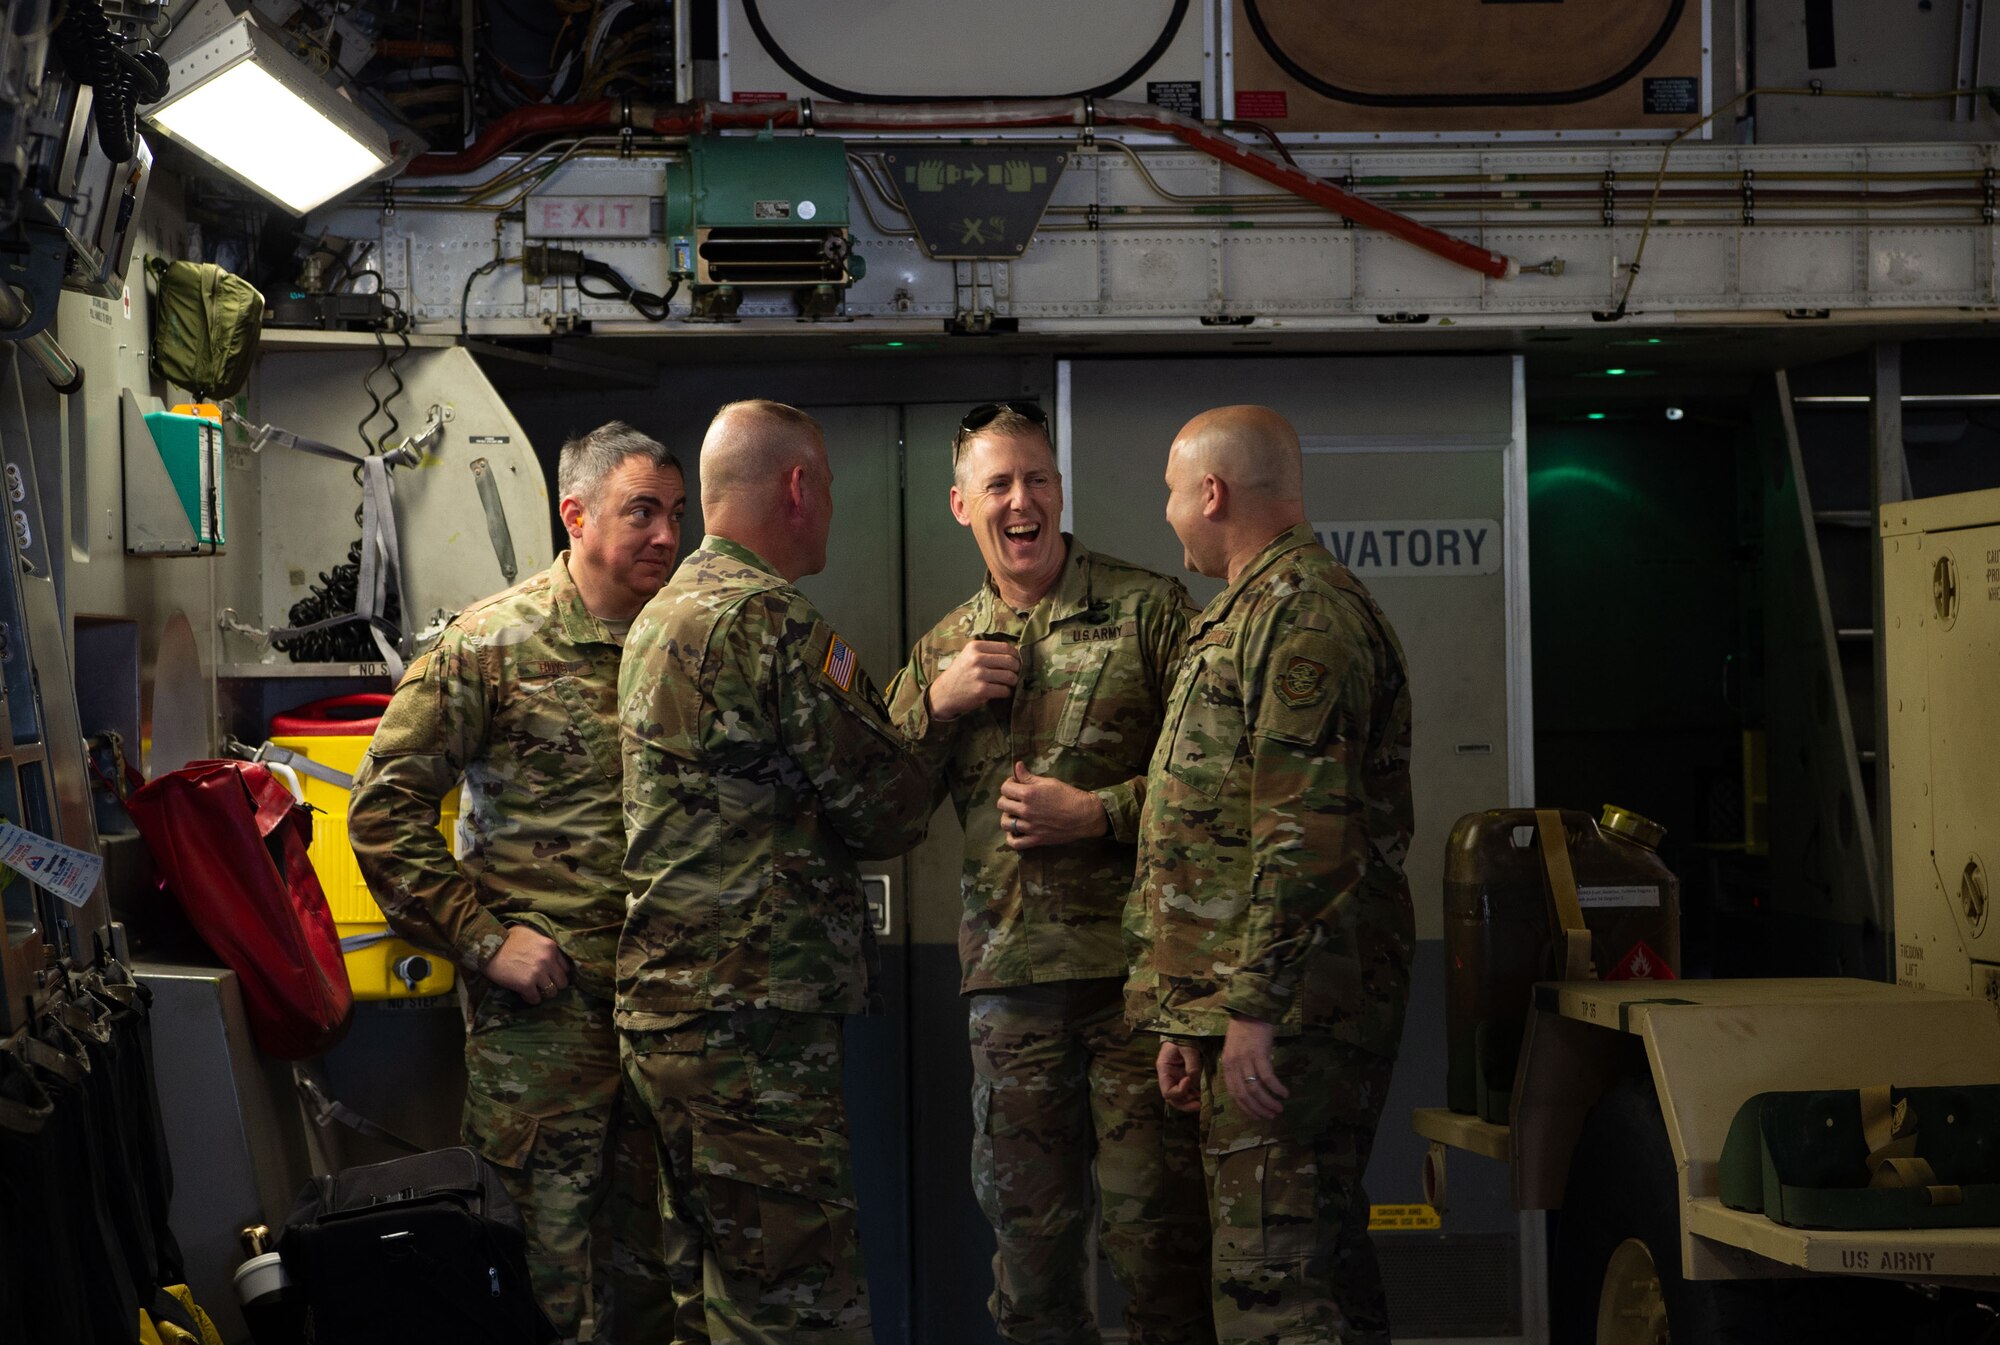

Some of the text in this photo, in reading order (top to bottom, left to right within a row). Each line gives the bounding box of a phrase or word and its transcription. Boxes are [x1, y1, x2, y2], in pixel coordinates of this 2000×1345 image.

[543, 204, 633, 228] EXIT
[1092, 625, 1122, 640] ARMY
[360, 663, 375, 675] NO
[1900, 944, 1923, 960] TIEDOWN
[1905, 962, 1918, 977] LIFT
[409, 996, 438, 1008] STEP
[1842, 1250, 1935, 1271] US ARMY
